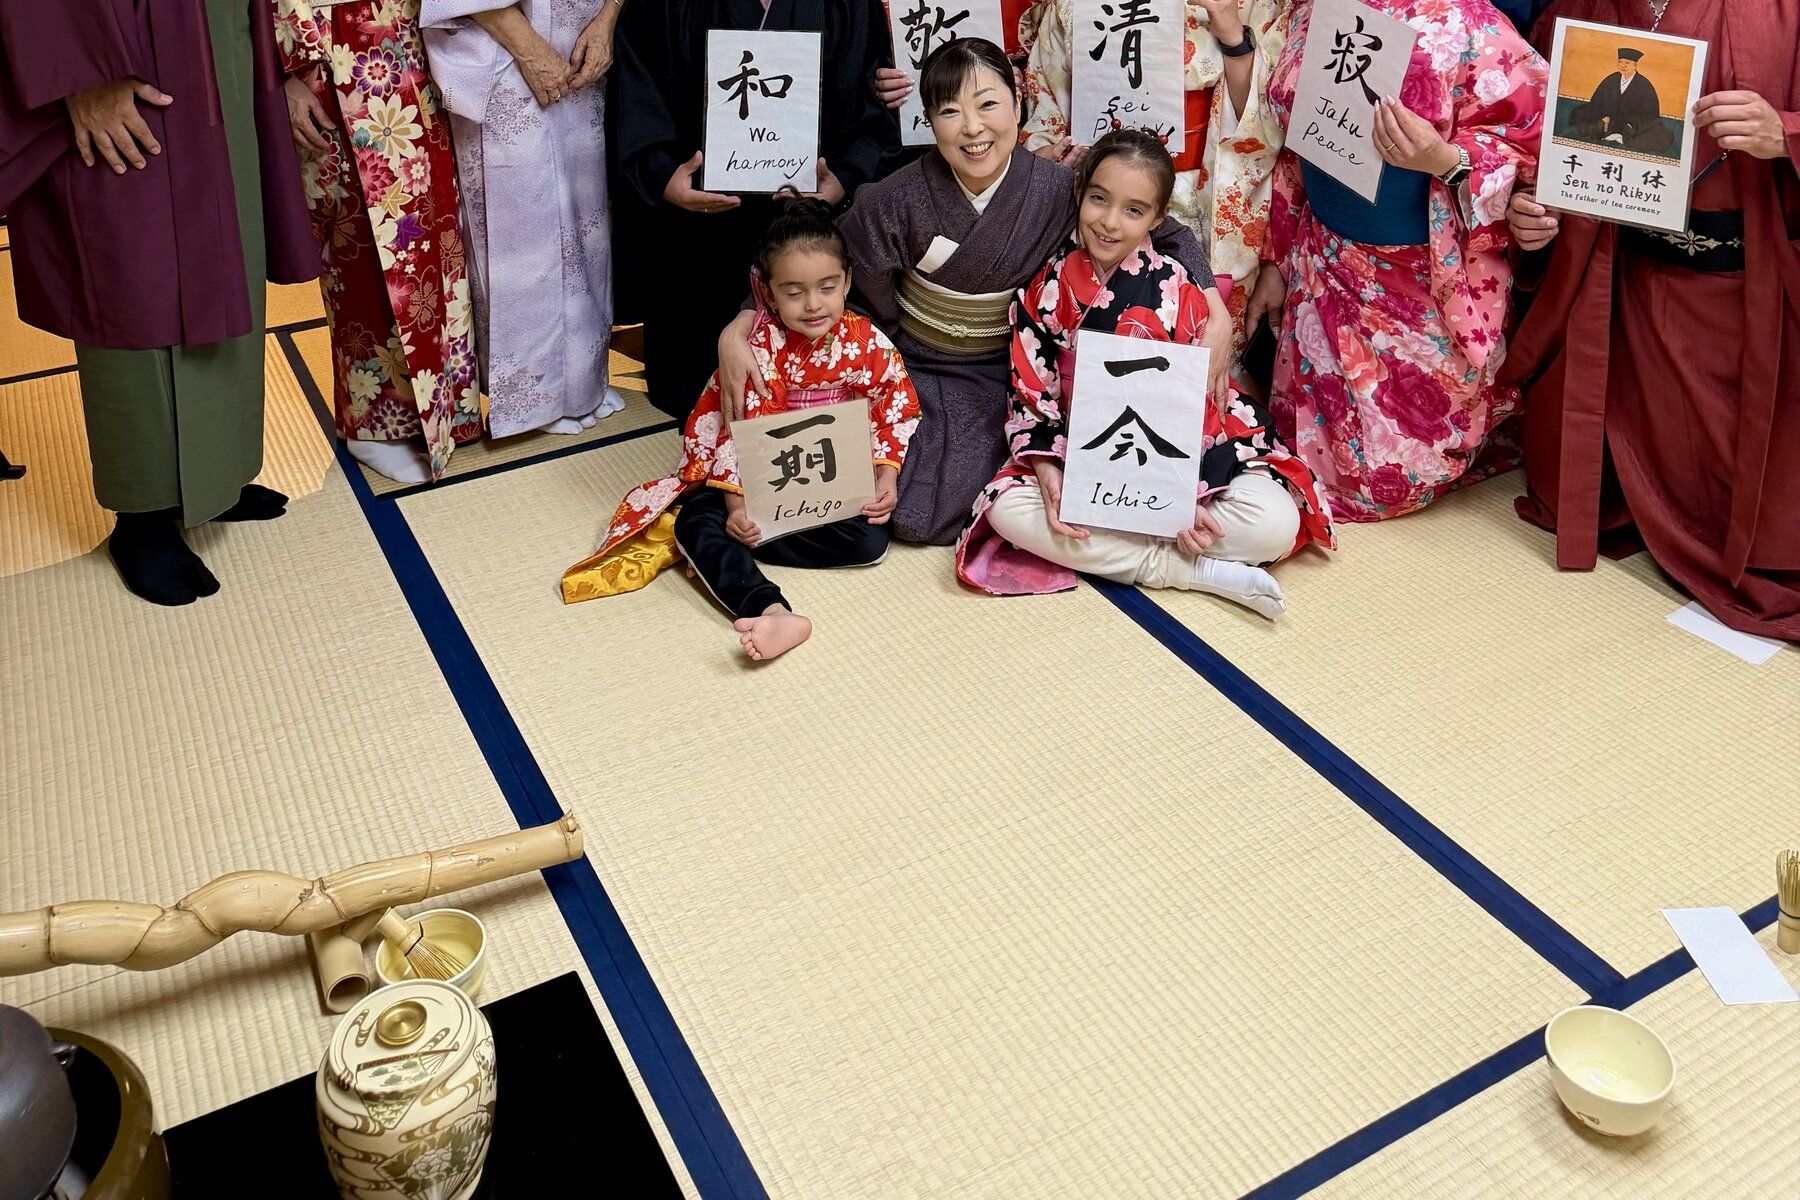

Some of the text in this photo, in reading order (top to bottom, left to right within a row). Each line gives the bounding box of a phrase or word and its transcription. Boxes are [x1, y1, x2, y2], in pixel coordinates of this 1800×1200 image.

[1322, 15, 1383, 107] 寂
[717, 50, 794, 121] 和
[1101, 91, 1151, 114] Sei
[1315, 96, 1364, 138] Jaku
[749, 127, 781, 143] Wa
[1303, 122, 1364, 165] Peace
[726, 150, 809, 179] harmony
[1562, 154, 1666, 190] 千利休
[1561, 190, 1661, 215] The father of tea ceremony
[1562, 174, 1662, 203] Sen no Rikyu
[773, 500, 842, 521] Ichigo
[1091, 482, 1174, 511] Ichie
